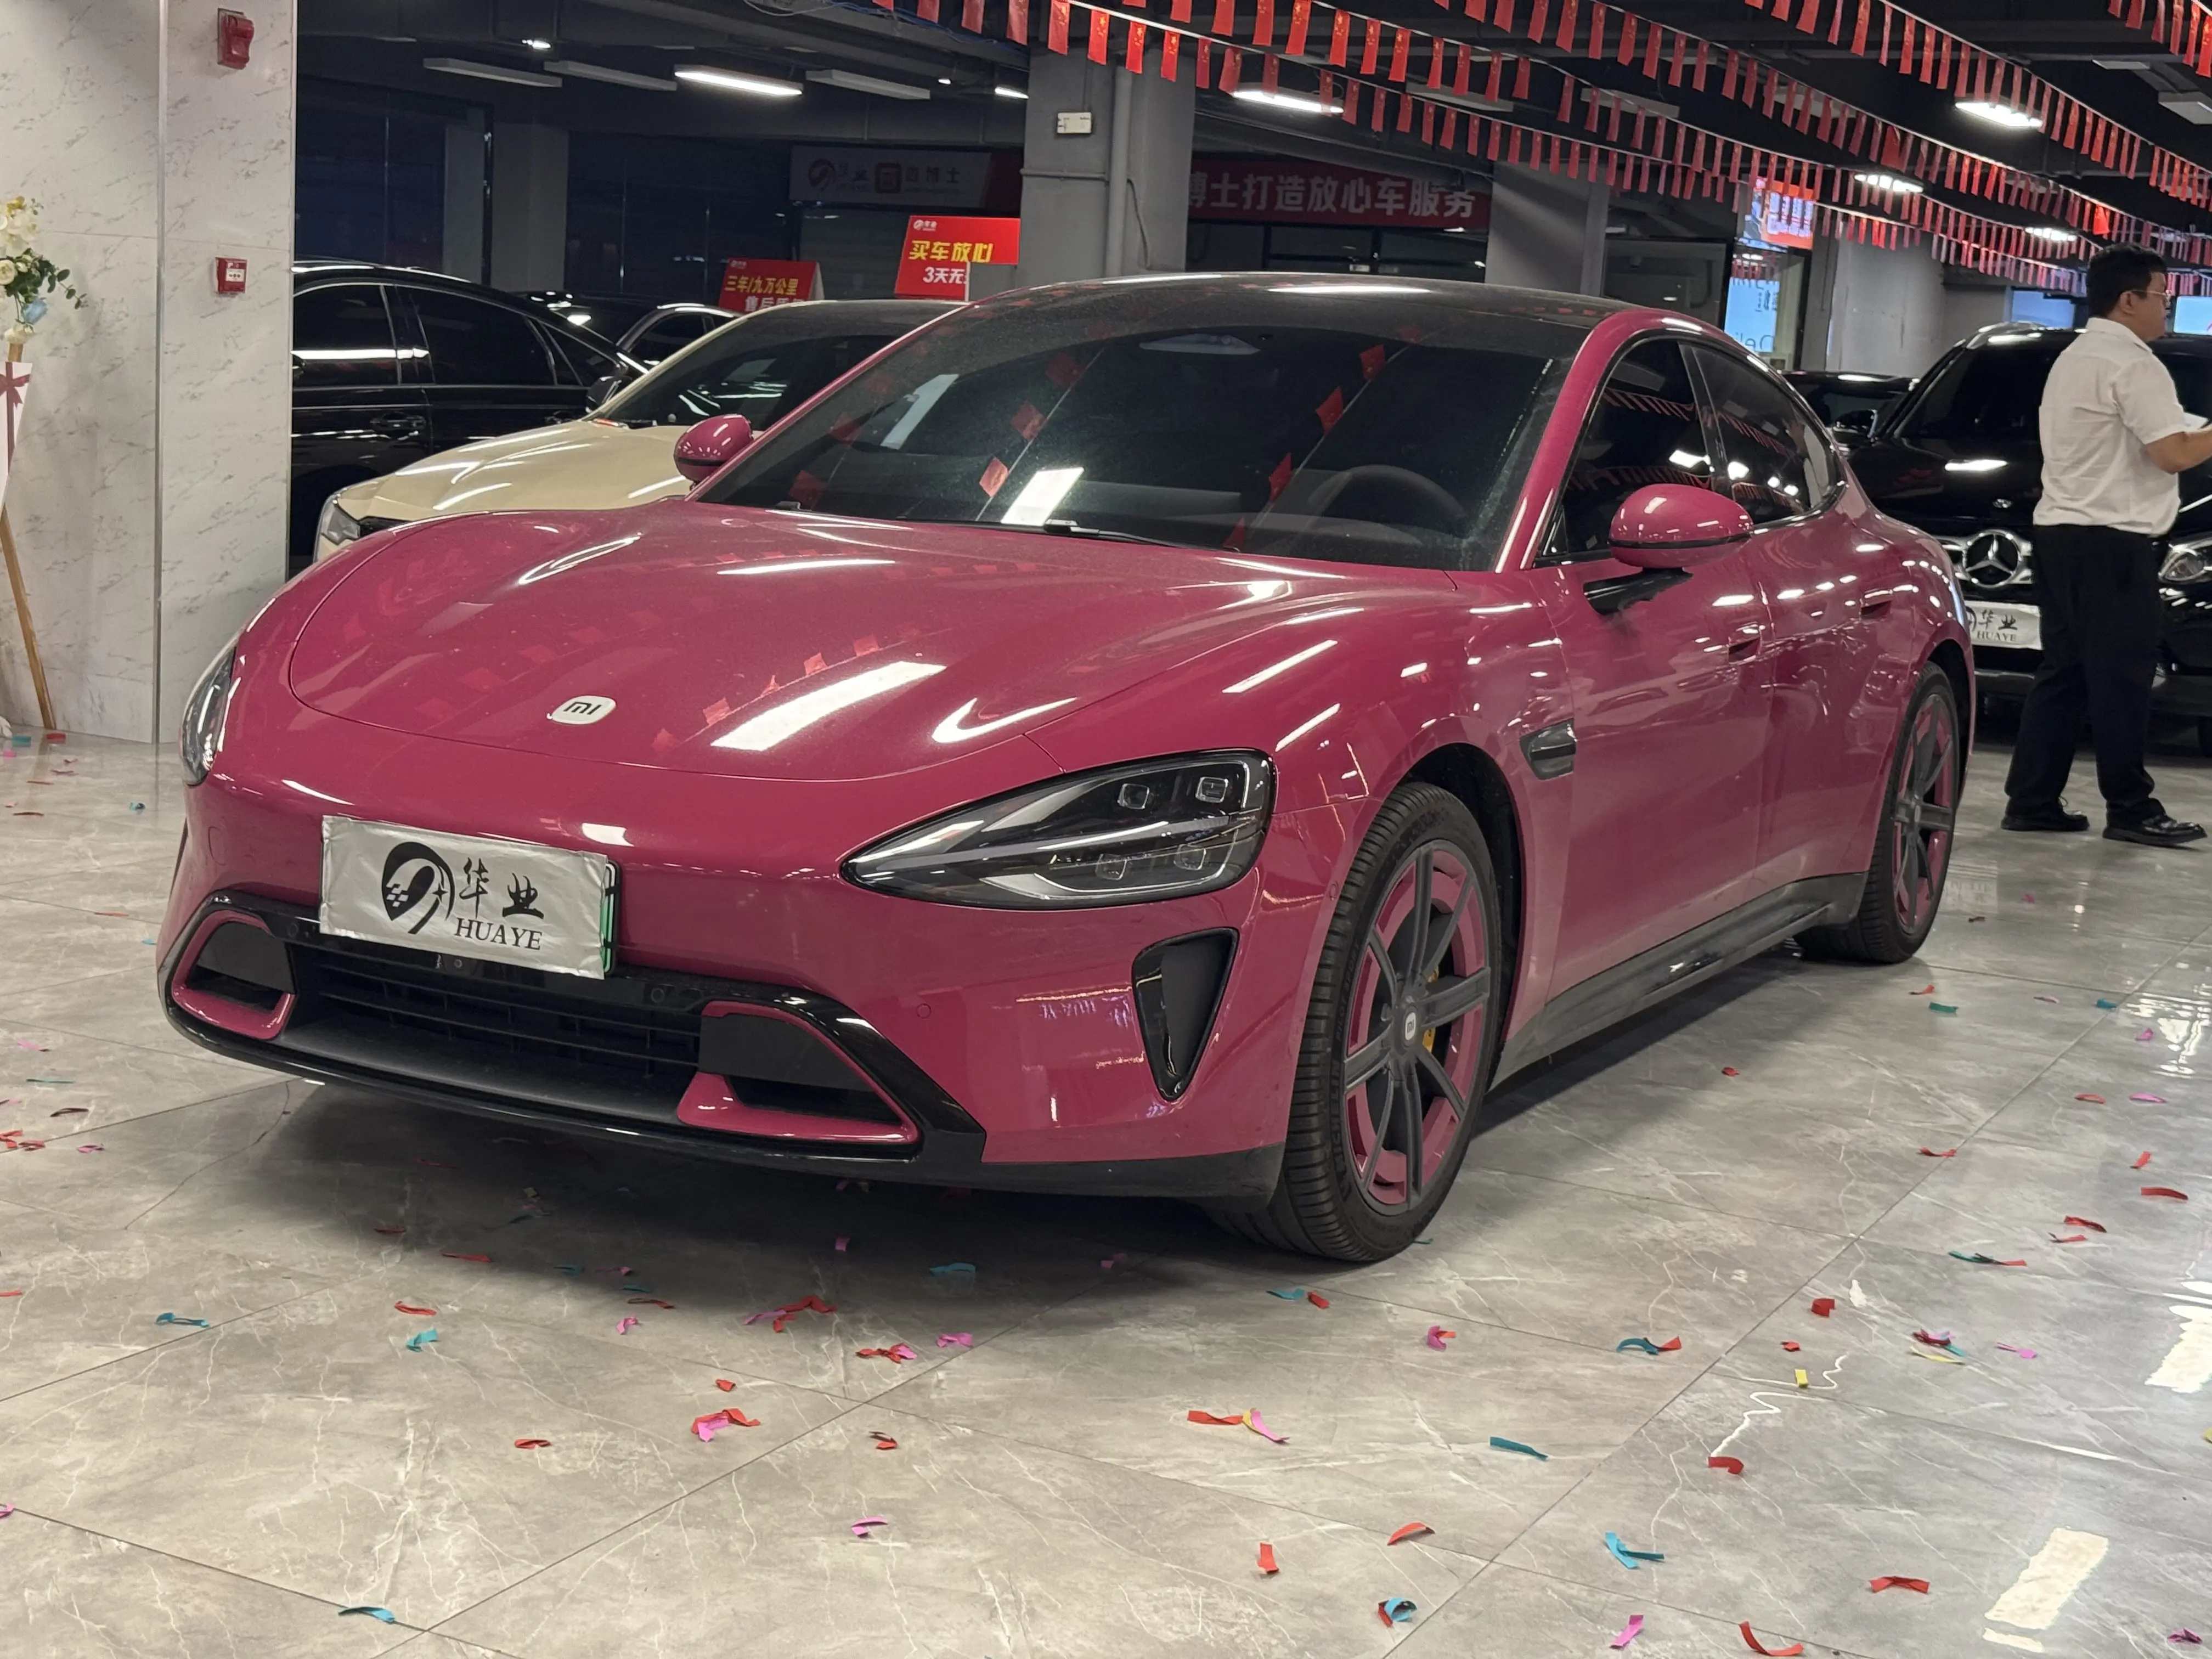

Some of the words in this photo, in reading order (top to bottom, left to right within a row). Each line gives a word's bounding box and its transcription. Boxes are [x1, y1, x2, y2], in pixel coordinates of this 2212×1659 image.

[909, 240, 994, 263] 买车放心
[724, 274, 799, 296] 三年/九万公里
[923, 267, 966, 284] 3天无
[1977, 608, 2018, 630] 华业
[1977, 630, 2017, 642] HUAYE
[459, 857, 544, 919] 华业
[454, 917, 543, 950] HUAYE
[1330, 1059, 1347, 1172] MICHELIN
